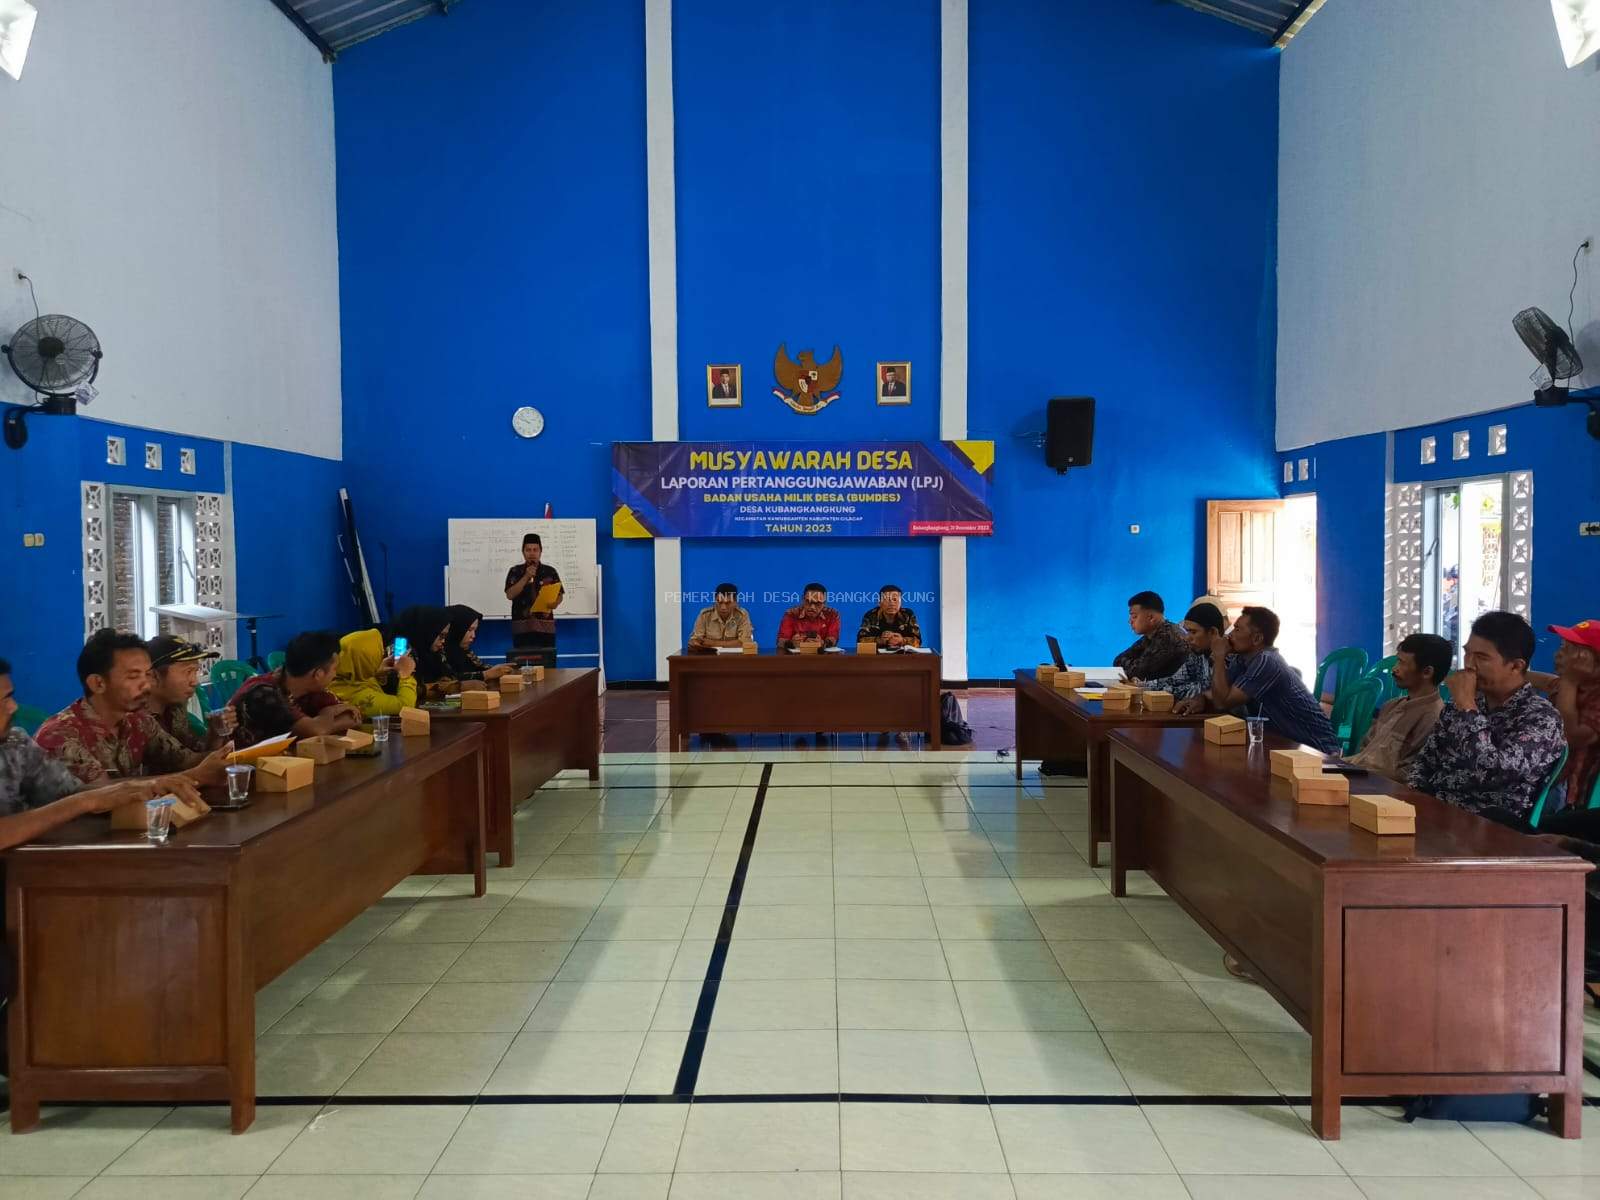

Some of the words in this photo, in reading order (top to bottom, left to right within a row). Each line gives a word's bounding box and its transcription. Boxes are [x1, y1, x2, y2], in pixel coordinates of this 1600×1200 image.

[689, 451, 851, 471] MUSYAWARAH
[857, 451, 913, 470] DESA
[661, 477, 729, 489] LAPORAN
[732, 476, 908, 489] PERTANGGUNGJAWABAN
[911, 476, 944, 491] (LPJ)
[703, 494, 742, 503] BADAN
[744, 494, 781, 503] USAHA
[784, 494, 814, 503] MILIK
[815, 494, 845, 503] DESA
[846, 494, 901, 503] (BUMDES)
[740, 506, 764, 514] DESA
[765, 506, 856, 514] KUBANGKANGKUNG
[765, 524, 803, 533] TAHUN
[805, 524, 832, 533] 2023
